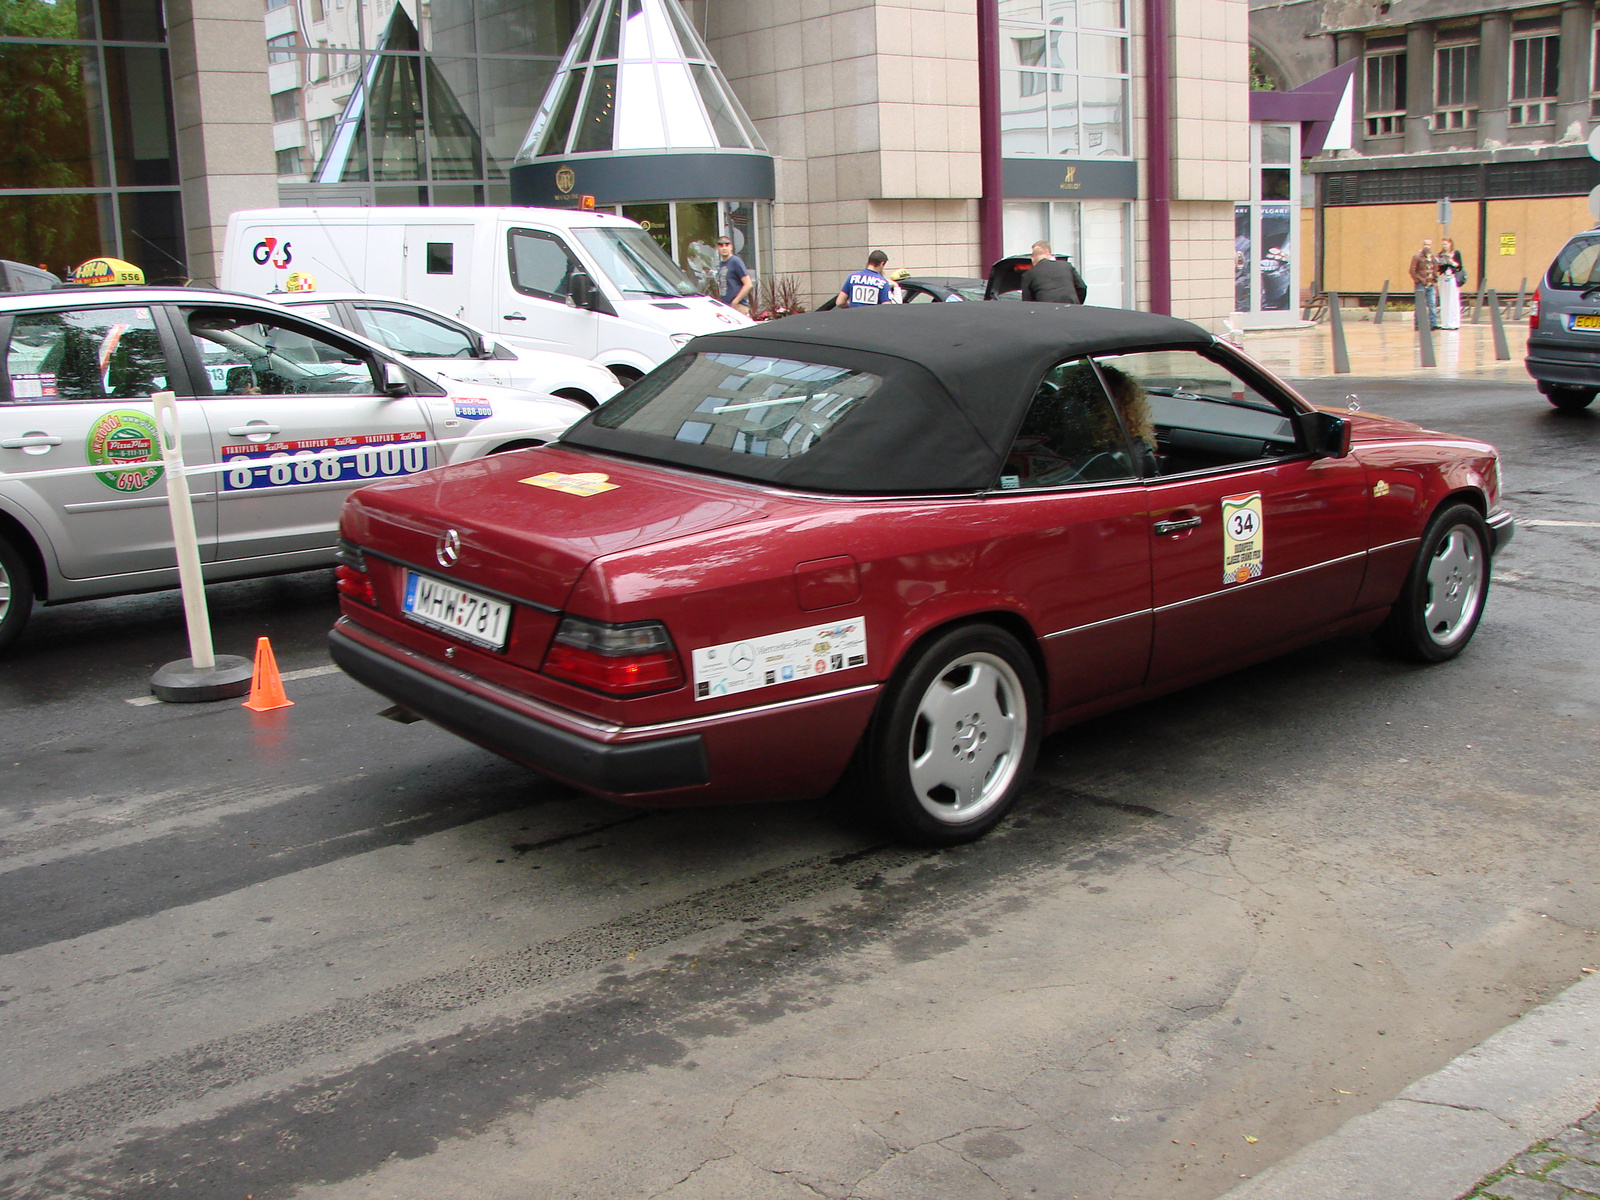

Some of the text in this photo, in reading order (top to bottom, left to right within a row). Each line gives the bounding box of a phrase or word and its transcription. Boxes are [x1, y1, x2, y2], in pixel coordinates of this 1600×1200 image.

[253, 237, 292, 269] G4S
[121, 273, 140, 281] 556
[850, 274, 887, 290] FRANCE
[855, 287, 876, 303] 012
[226, 431, 422, 455] TAXIPLUS TaxiPlus TAXIPLUS TaxiPlus TAXIPLUS TaxiPlus
[229, 442, 424, 489] 8-888-000
[1234, 513, 1254, 535] 34
